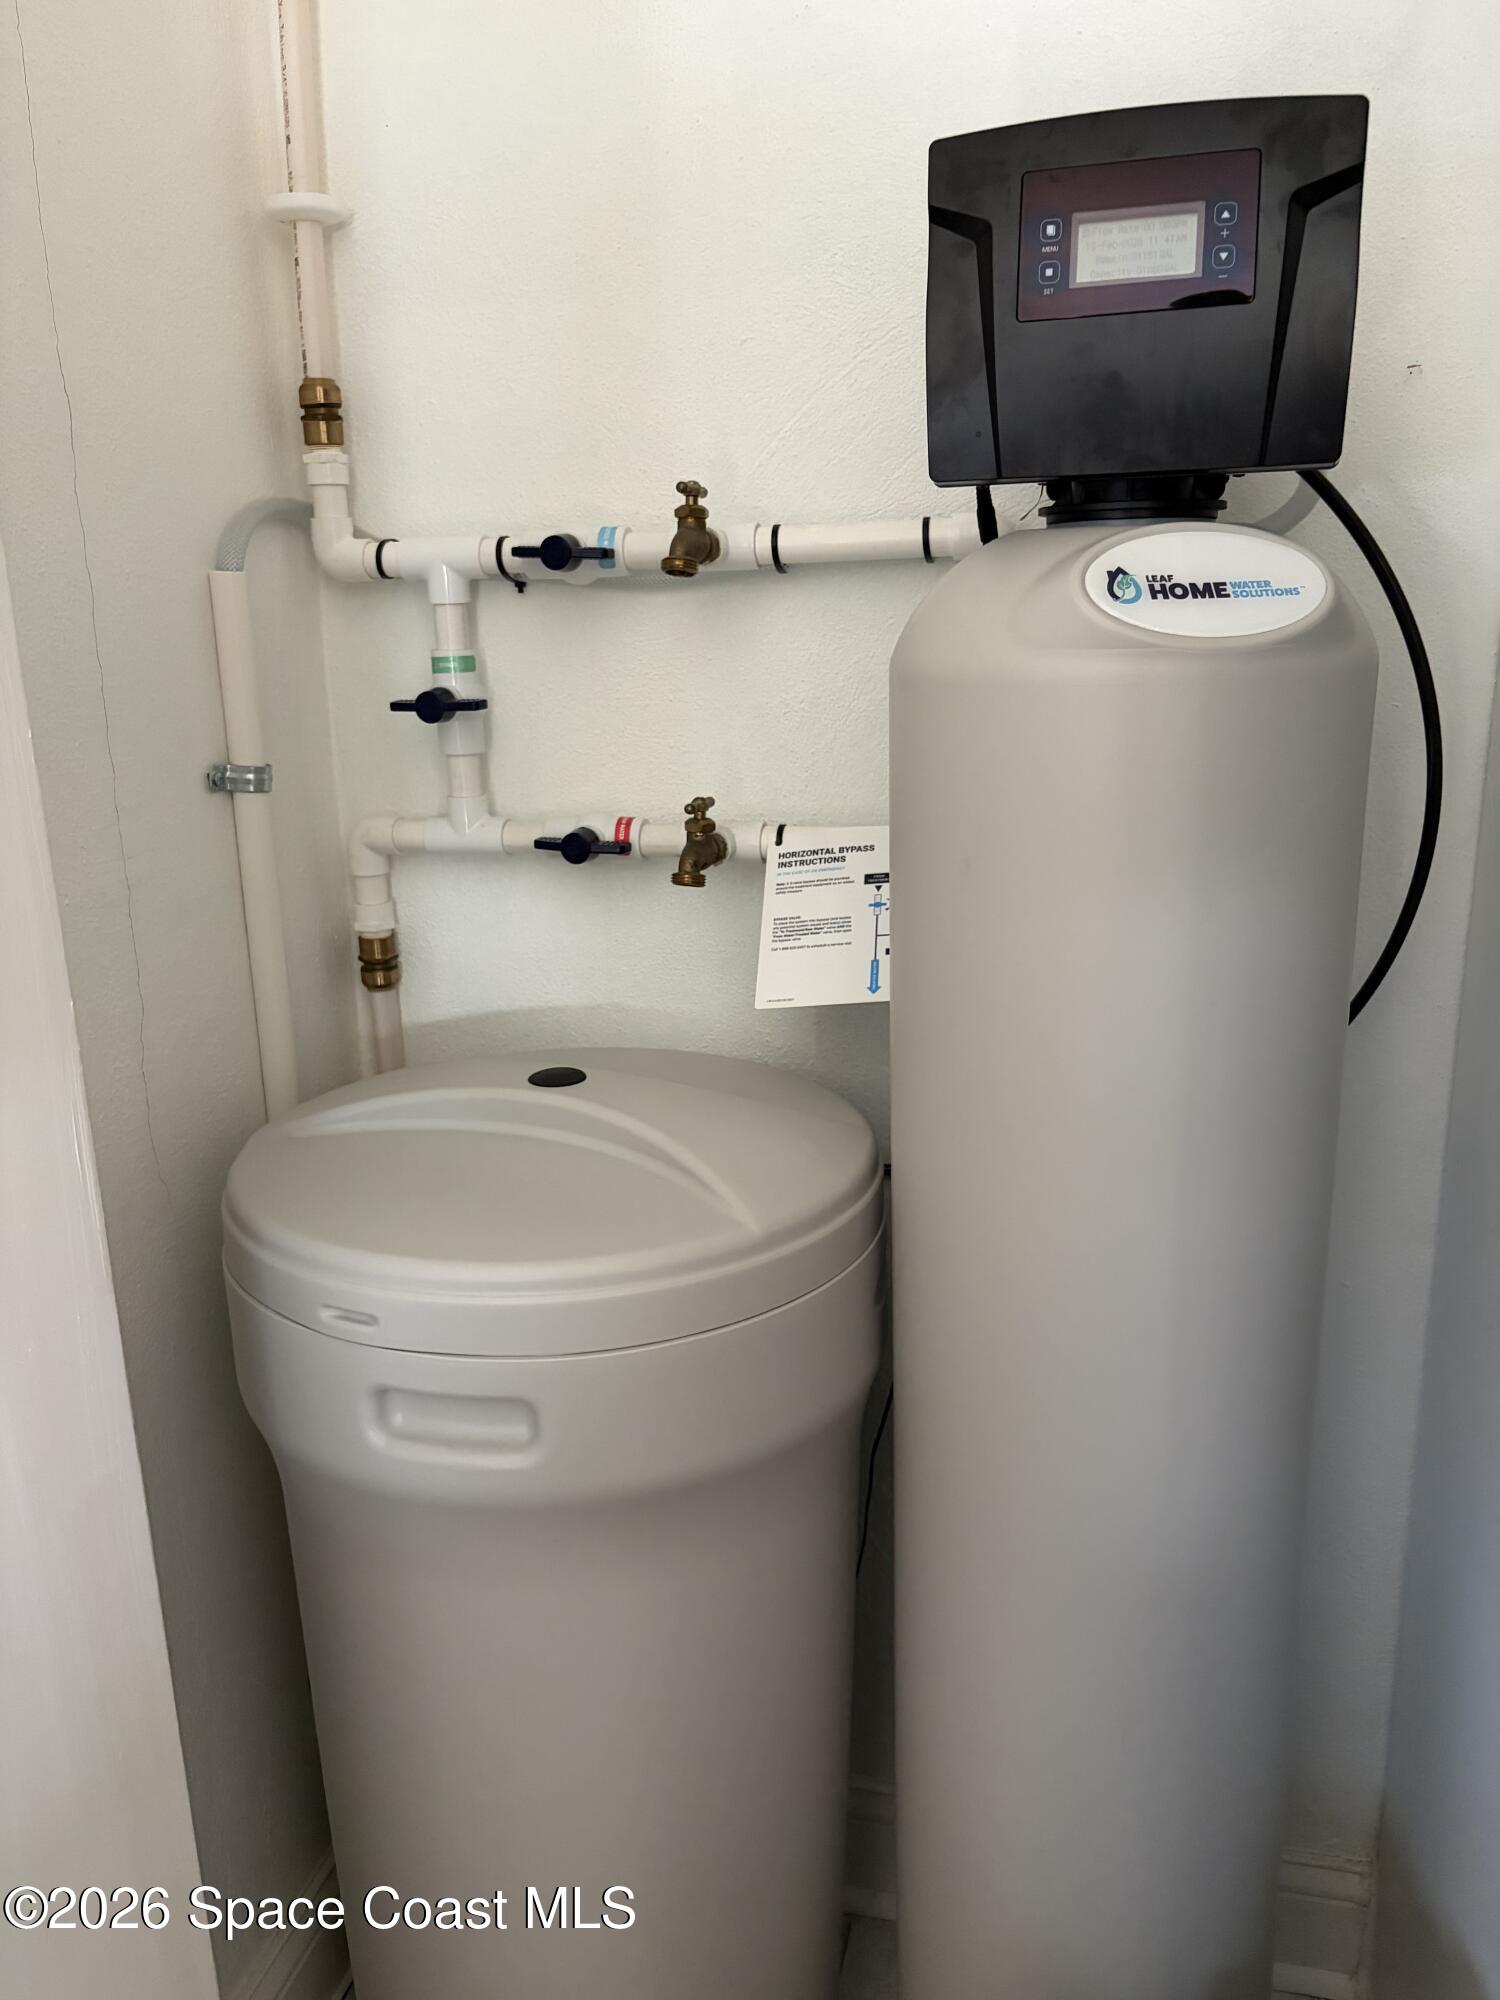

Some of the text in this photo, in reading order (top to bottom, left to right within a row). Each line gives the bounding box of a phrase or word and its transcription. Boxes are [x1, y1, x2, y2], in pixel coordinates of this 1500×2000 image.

[1041, 245, 1059, 253] MENU
[1145, 574, 1174, 583] LEAF
[1229, 580, 1272, 589] WATER
[1149, 581, 1231, 600] HOME
[1231, 587, 1301, 599] SOLUTIONS
[778, 844, 875, 860] HORIZONTAL BYPASS
[777, 855, 847, 869] INSTRUCTIONS
